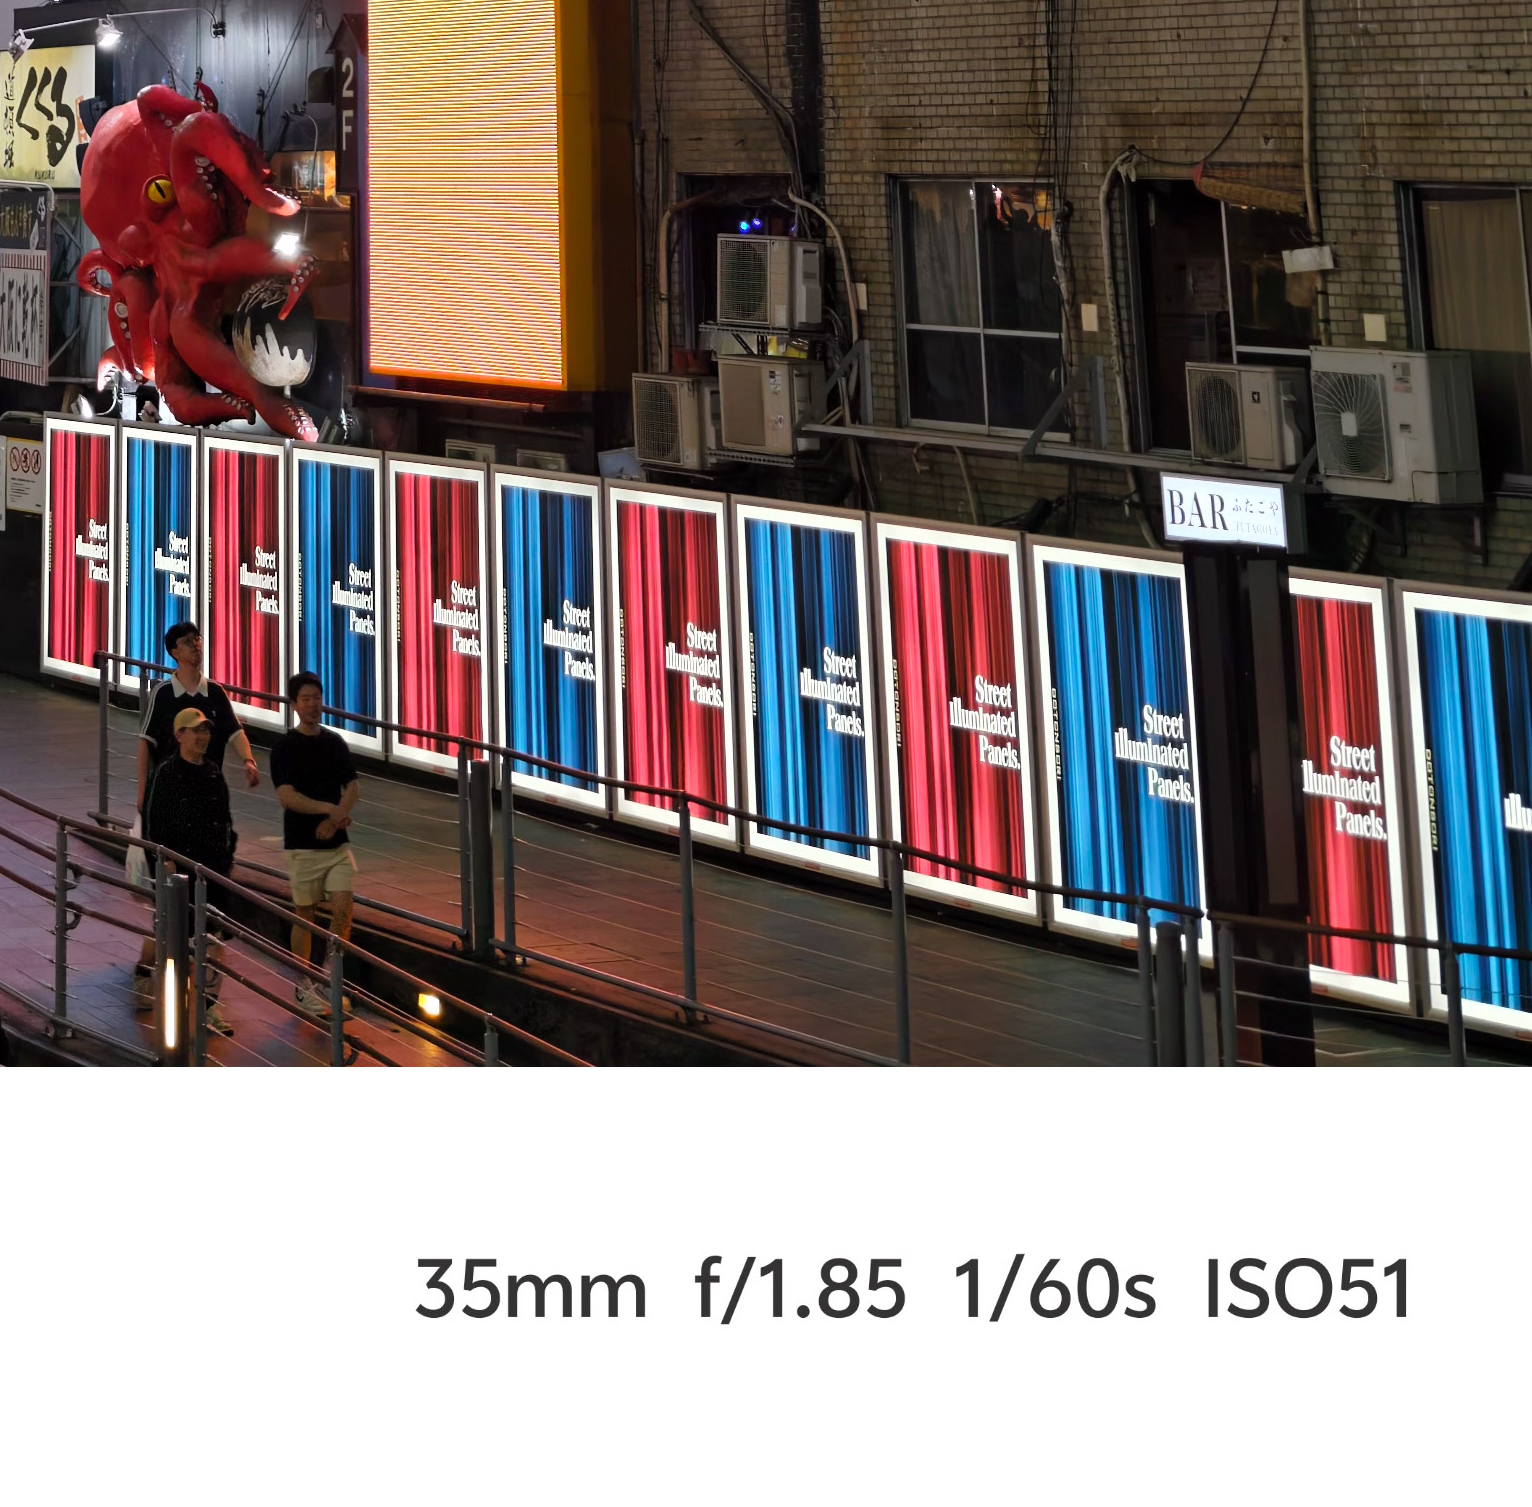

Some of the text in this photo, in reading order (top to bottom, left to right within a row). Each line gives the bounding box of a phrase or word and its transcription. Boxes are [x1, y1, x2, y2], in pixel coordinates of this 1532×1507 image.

[16, 66, 75, 167] くくる
[1166, 488, 1229, 531] BAR
[1232, 498, 1279, 517] ふたごや
[255, 545, 277, 570] Street
[348, 562, 372, 589] Street
[255, 590, 279, 615] Panels.
[451, 580, 477, 607] Street
[349, 609, 376, 636] Panels.
[562, 600, 591, 626] Street
[452, 633, 482, 657] Panels.
[686, 623, 718, 652] Street
[564, 652, 596, 681] Panels.
[823, 647, 857, 678] Street
[689, 678, 724, 708] Panels.
[974, 675, 1012, 708] Street
[826, 705, 865, 738] Panels.
[1142, 705, 1185, 739] Street
[978, 734, 1021, 770] Panels.
[1329, 735, 1376, 772] Street
[1147, 767, 1195, 804] Panels.
[1334, 800, 1388, 841] Panels.
